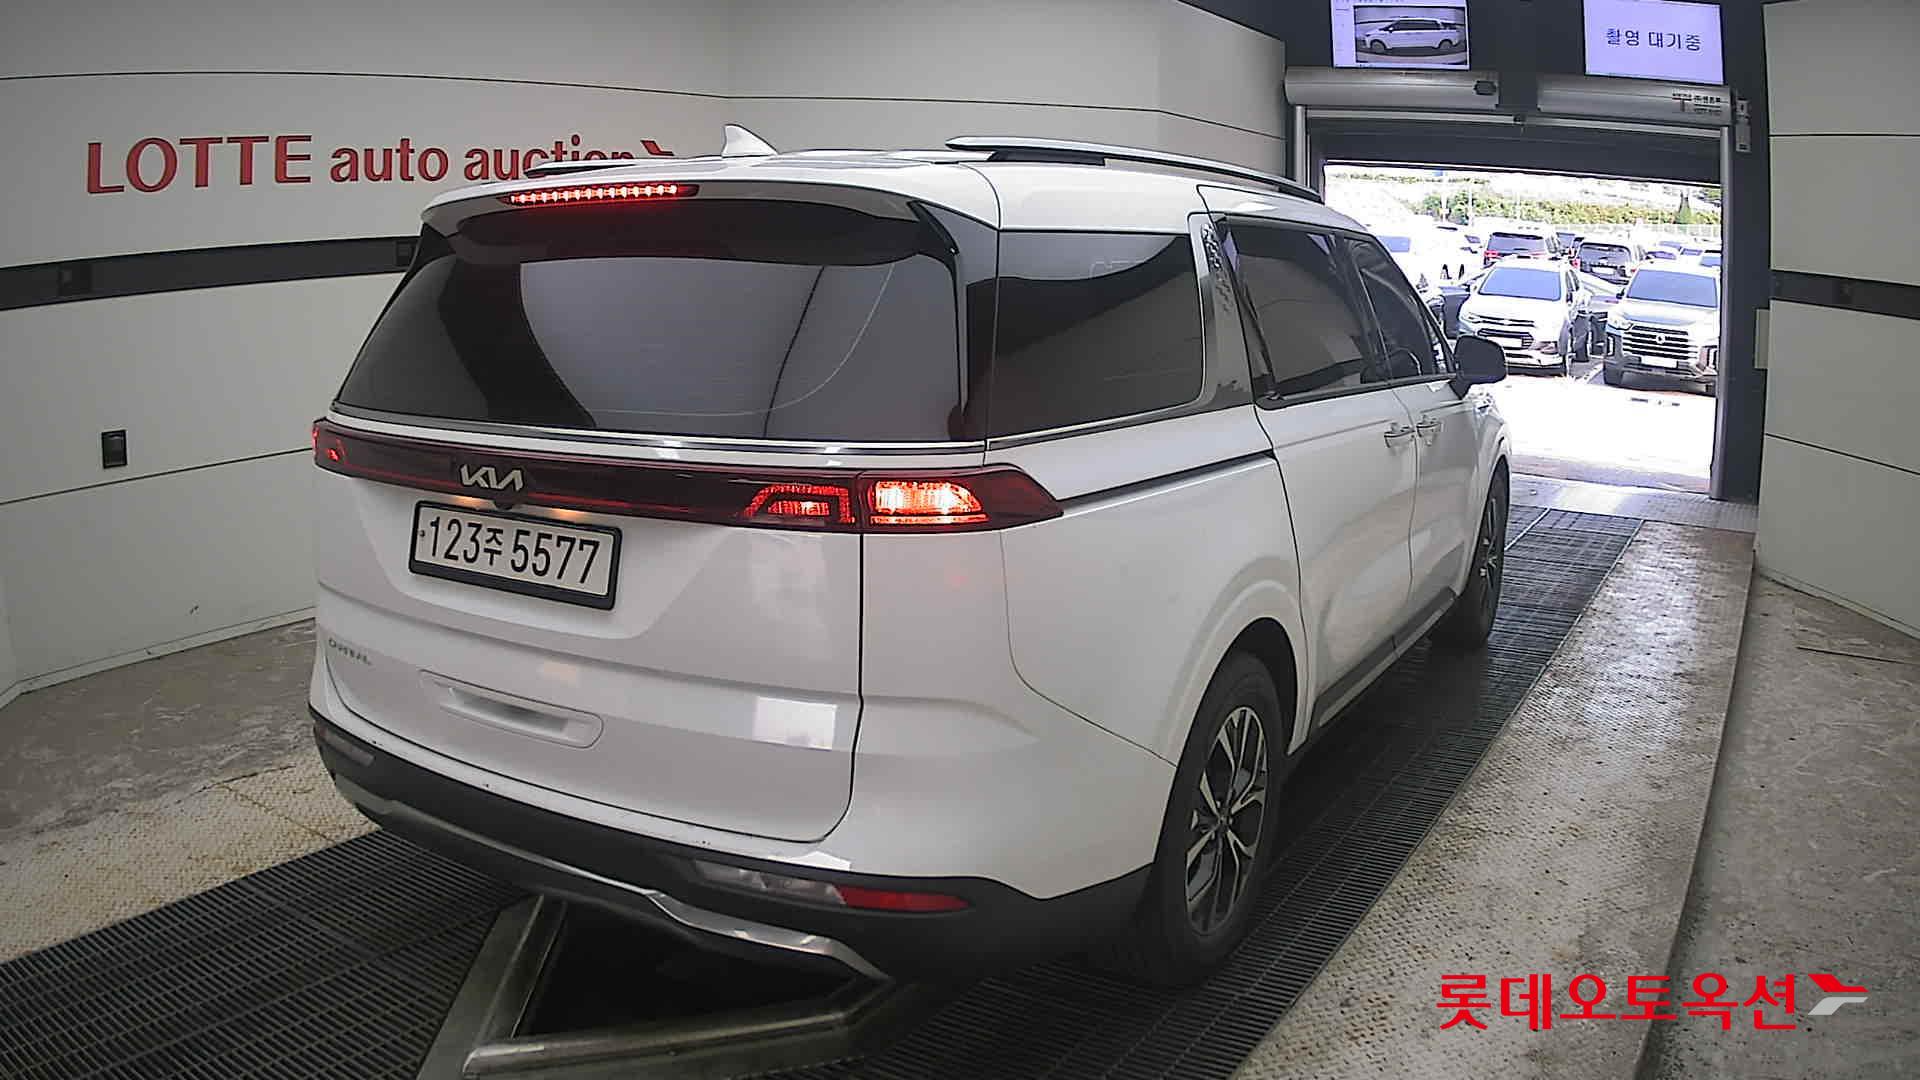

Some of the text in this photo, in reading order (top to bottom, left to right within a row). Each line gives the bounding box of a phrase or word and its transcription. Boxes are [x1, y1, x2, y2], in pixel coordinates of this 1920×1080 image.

[1648, 31, 1702, 51] 대기중
[87, 135, 312, 194] LOTTE
[330, 138, 449, 182] auto
[459, 463, 525, 492] KIA
[510, 529, 601, 585] 5577
